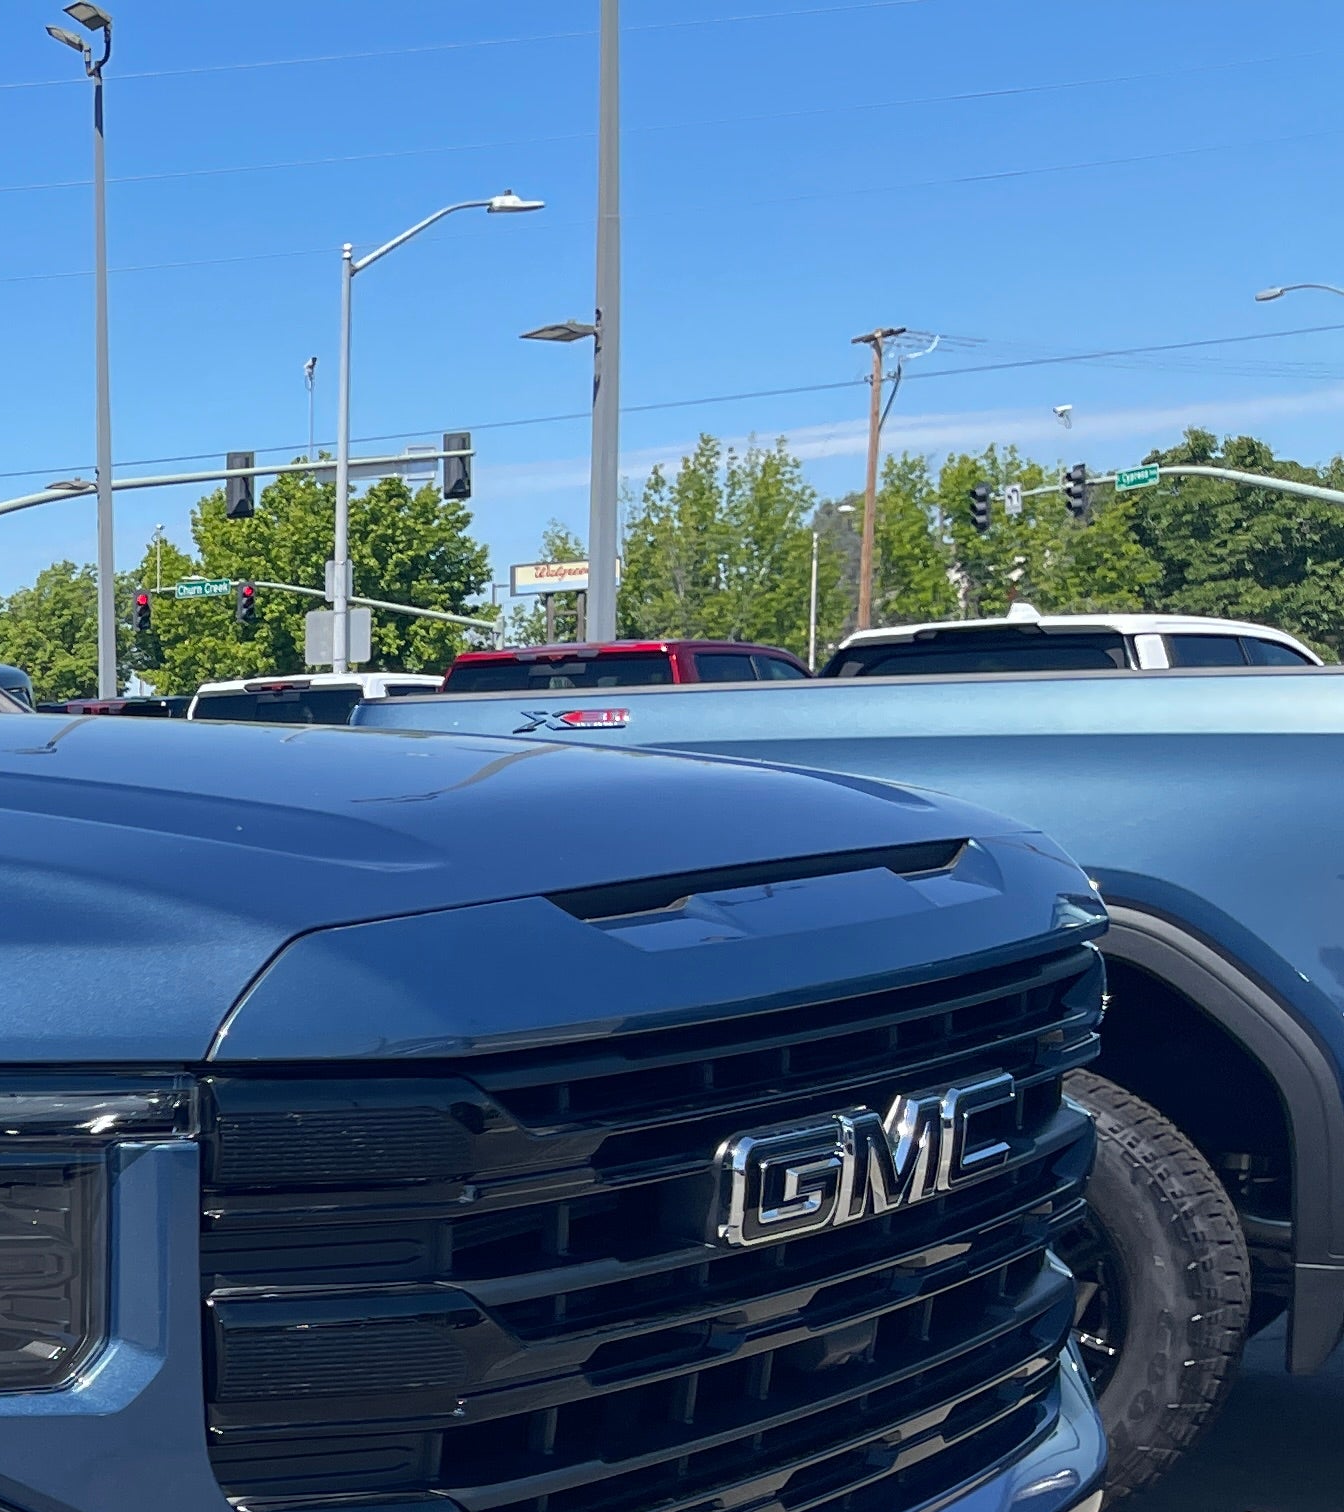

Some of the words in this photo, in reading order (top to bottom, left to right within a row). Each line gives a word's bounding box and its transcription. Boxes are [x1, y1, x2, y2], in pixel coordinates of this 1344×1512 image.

[178, 585, 202, 596] Churn
[204, 582, 228, 595] Creek
[713, 1071, 1015, 1247] GMC
